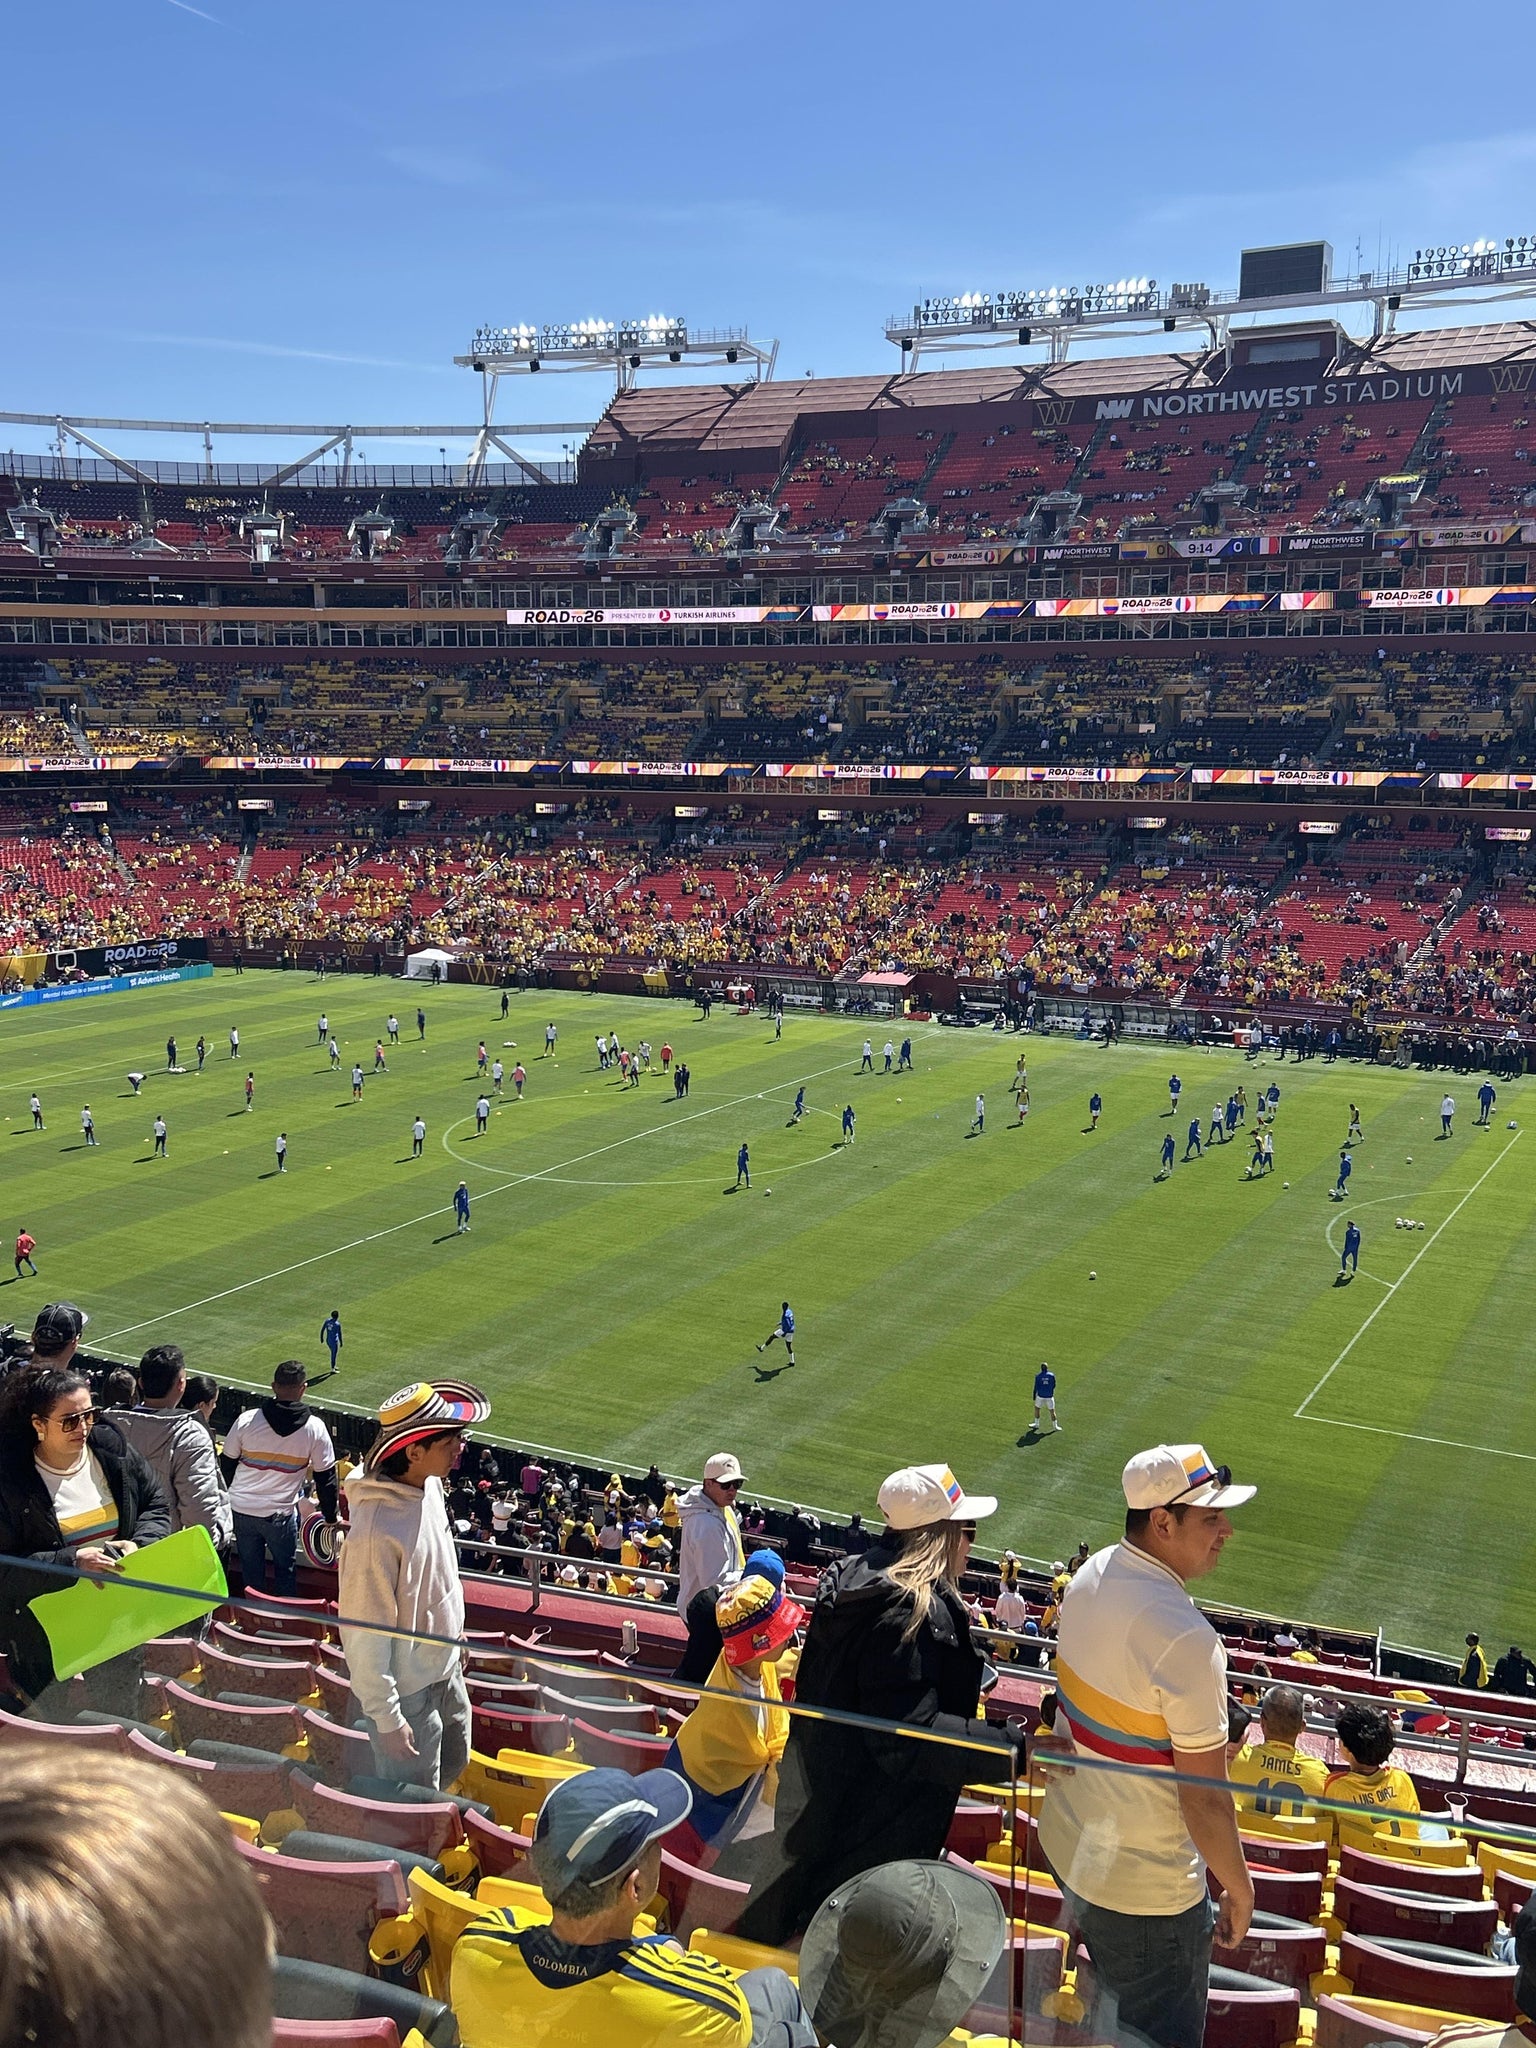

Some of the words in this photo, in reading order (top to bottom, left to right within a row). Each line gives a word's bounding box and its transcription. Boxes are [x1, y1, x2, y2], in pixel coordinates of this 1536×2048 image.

[1095, 399, 1134, 420] NW
[1143, 385, 1318, 417] NORTHWEST
[1324, 372, 1463, 404] STADIUM
[1438, 531, 1464, 540] ROAD
[1188, 543, 1213, 554] 9:14
[1233, 541, 1243, 552] 0
[1288, 538, 1312, 550] NW
[1311, 536, 1365, 545] NORTHWEST
[1043, 549, 1064, 560] NW
[1063, 546, 1113, 556] NORTHWEST
[1157, 544, 1165, 555] 0
[947, 552, 968, 560] ROAD
[1376, 592, 1409, 600] ROAD
[1418, 590, 1433, 599] 26
[1122, 599, 1151, 608] ROAD
[1159, 598, 1173, 607] 26
[891, 605, 919, 613] ROAD
[524, 610, 570, 624] ROAD
[571, 615, 583, 623] TO
[583, 610, 604, 623] 26
[705, 611, 736, 619] AIRLINES
[45, 758, 71, 766] ROAD
[453, 759, 475, 767] ROAD
[671, 763, 682, 771] 26
[1048, 768, 1075, 776] ROAD
[1082, 768, 1094, 776] 26
[1278, 771, 1309, 780] ROAD
[1316, 771, 1330, 780] 26
[104, 945, 147, 963] ROAD
[158, 941, 178, 955] 26
[137, 972, 181, 985] AdventHealth
[43, 991, 60, 999] Mental
[61, 988, 78, 996] Health
[1260, 1754, 1301, 1776] JAMES
[532, 1954, 589, 1977] COLOMBIA
